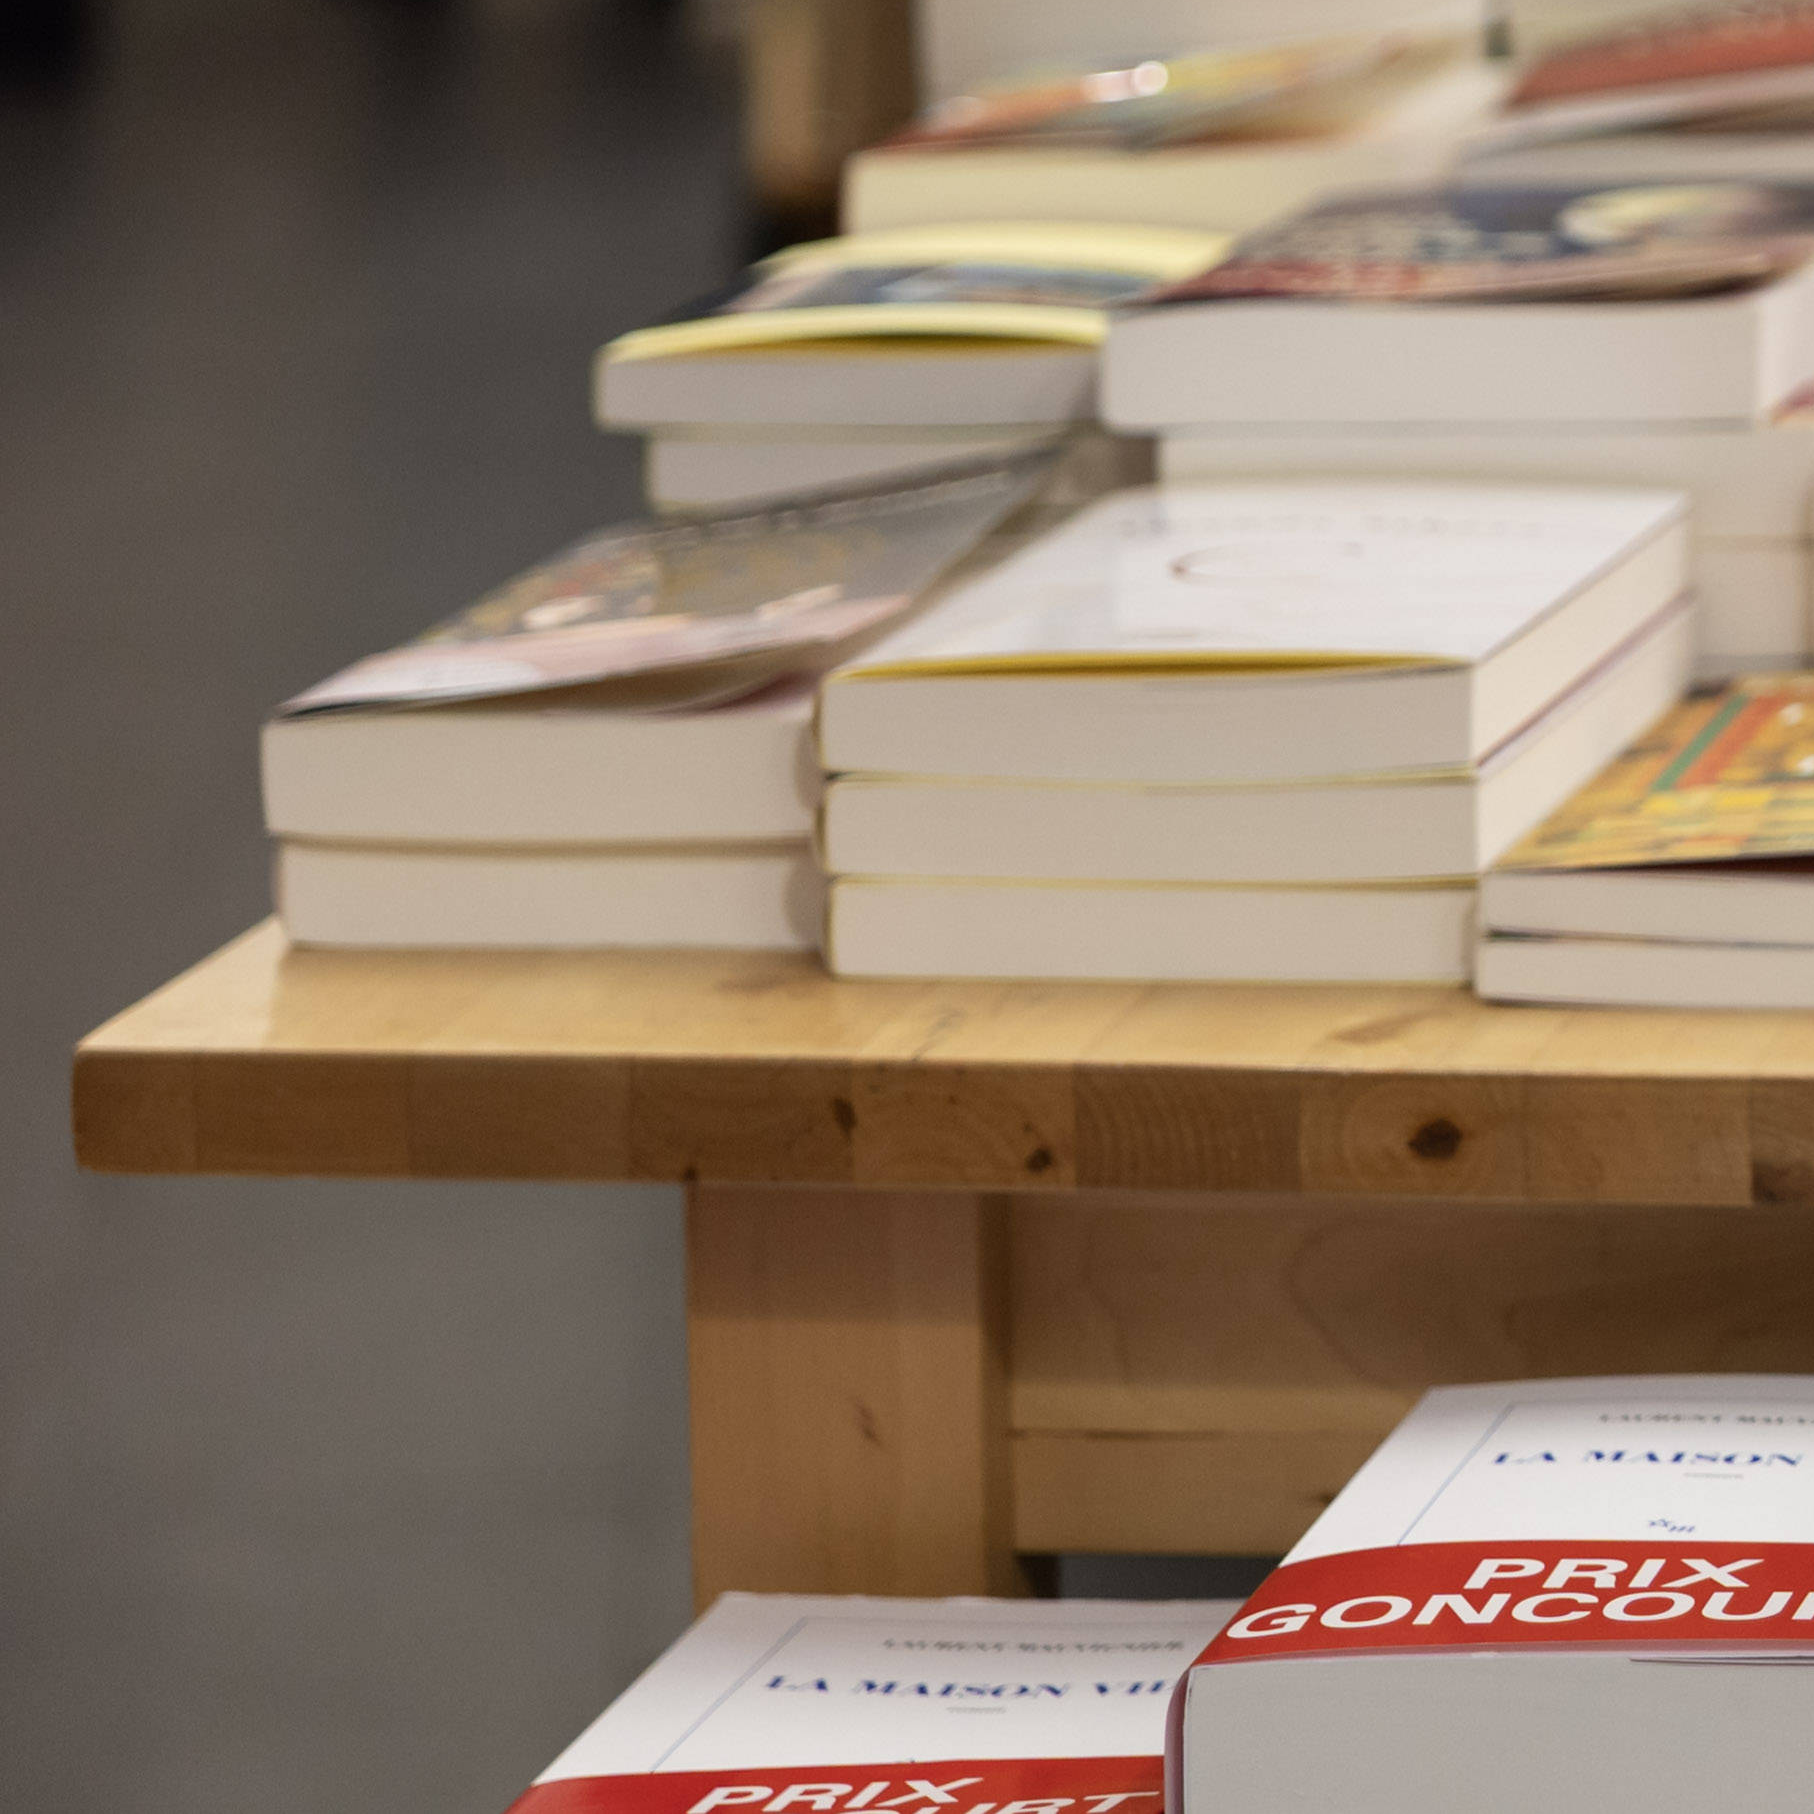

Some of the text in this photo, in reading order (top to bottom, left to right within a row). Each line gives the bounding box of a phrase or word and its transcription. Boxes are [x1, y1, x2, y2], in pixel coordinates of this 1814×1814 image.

[1493, 1451, 1558, 1465] LA
[1582, 1449, 1803, 1467] MAISON
[1463, 1558, 1766, 1590] PRIX
[764, 1675, 830, 1692] LA
[852, 1679, 1070, 1697] MAISON
[687, 1777, 983, 1814] PRIX
